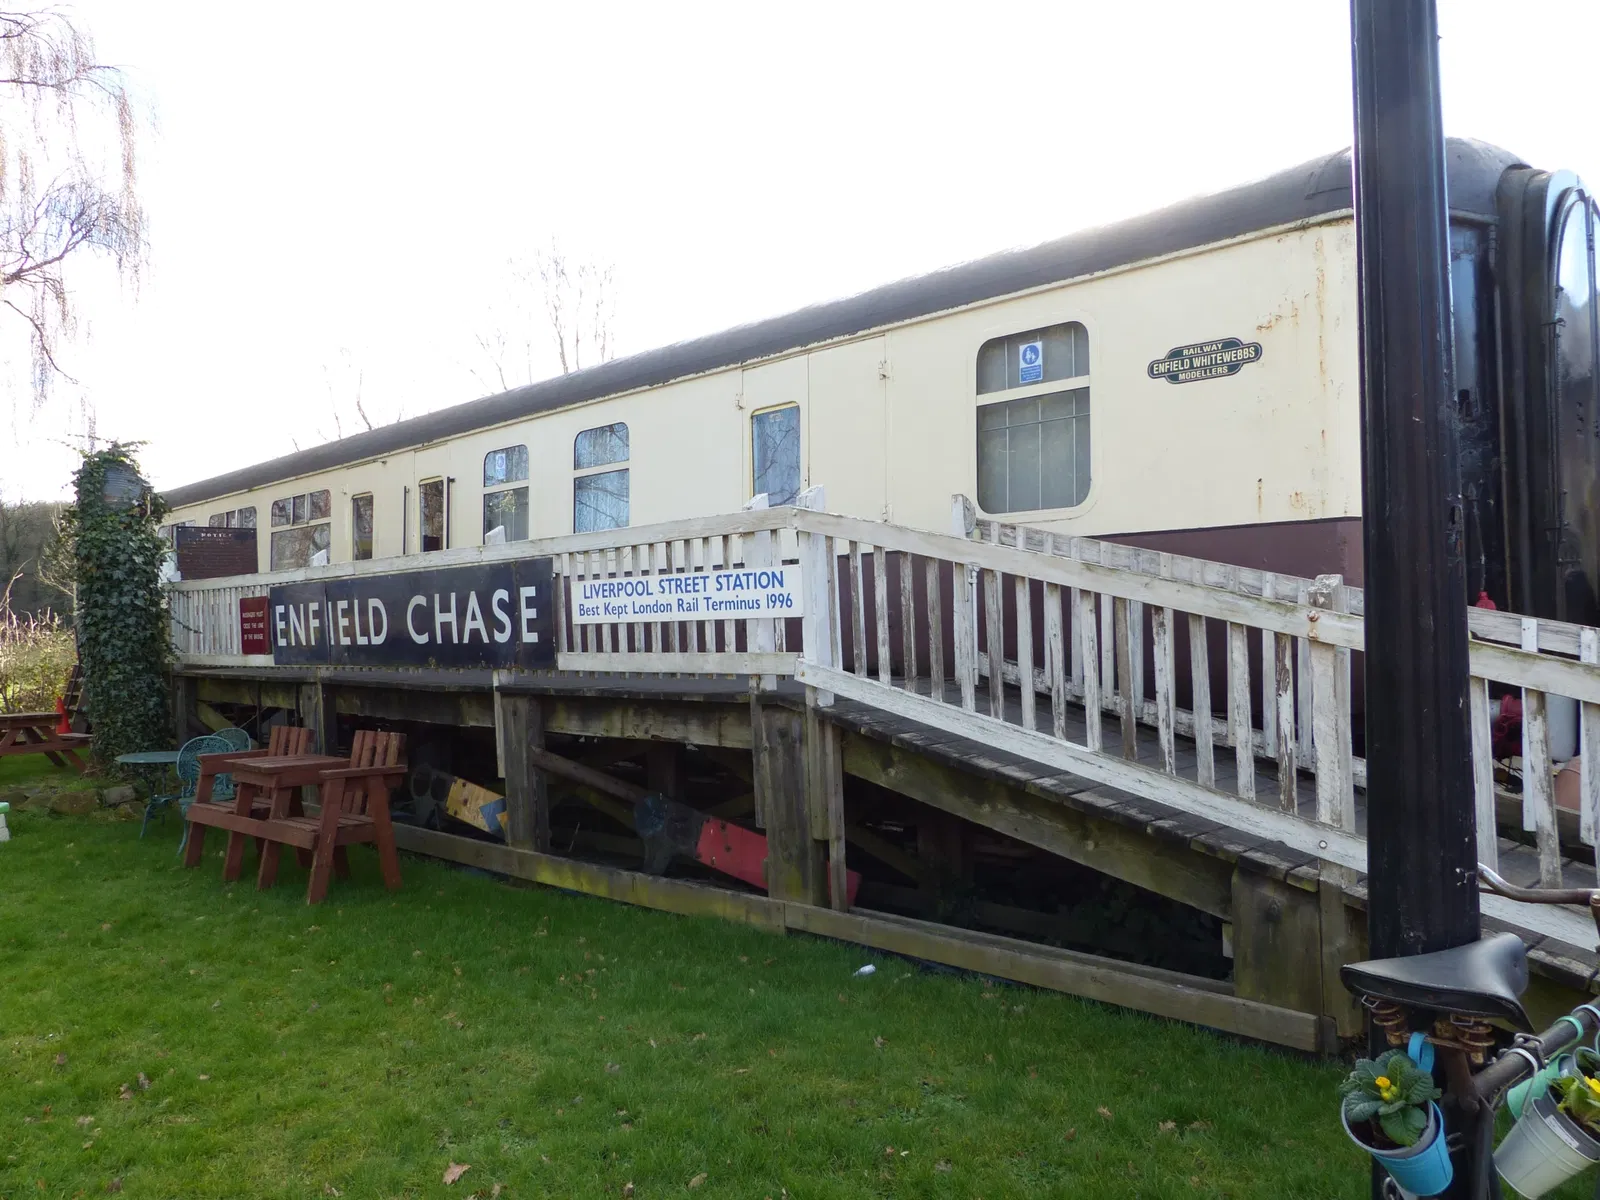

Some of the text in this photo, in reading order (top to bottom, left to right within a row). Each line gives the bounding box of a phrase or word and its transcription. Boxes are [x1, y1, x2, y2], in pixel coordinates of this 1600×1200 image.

[1153, 346, 1255, 374] ENFIELD WHITEWEBBS
[1183, 343, 1223, 356] RAILWAY
[1178, 366, 1228, 381] MODELLERS
[583, 571, 784, 600] LIVERPOOL STREET STATION
[275, 586, 538, 647] ENFIELD CHASE
[579, 592, 793, 619] Best Kept London Rail Terminus 1996
